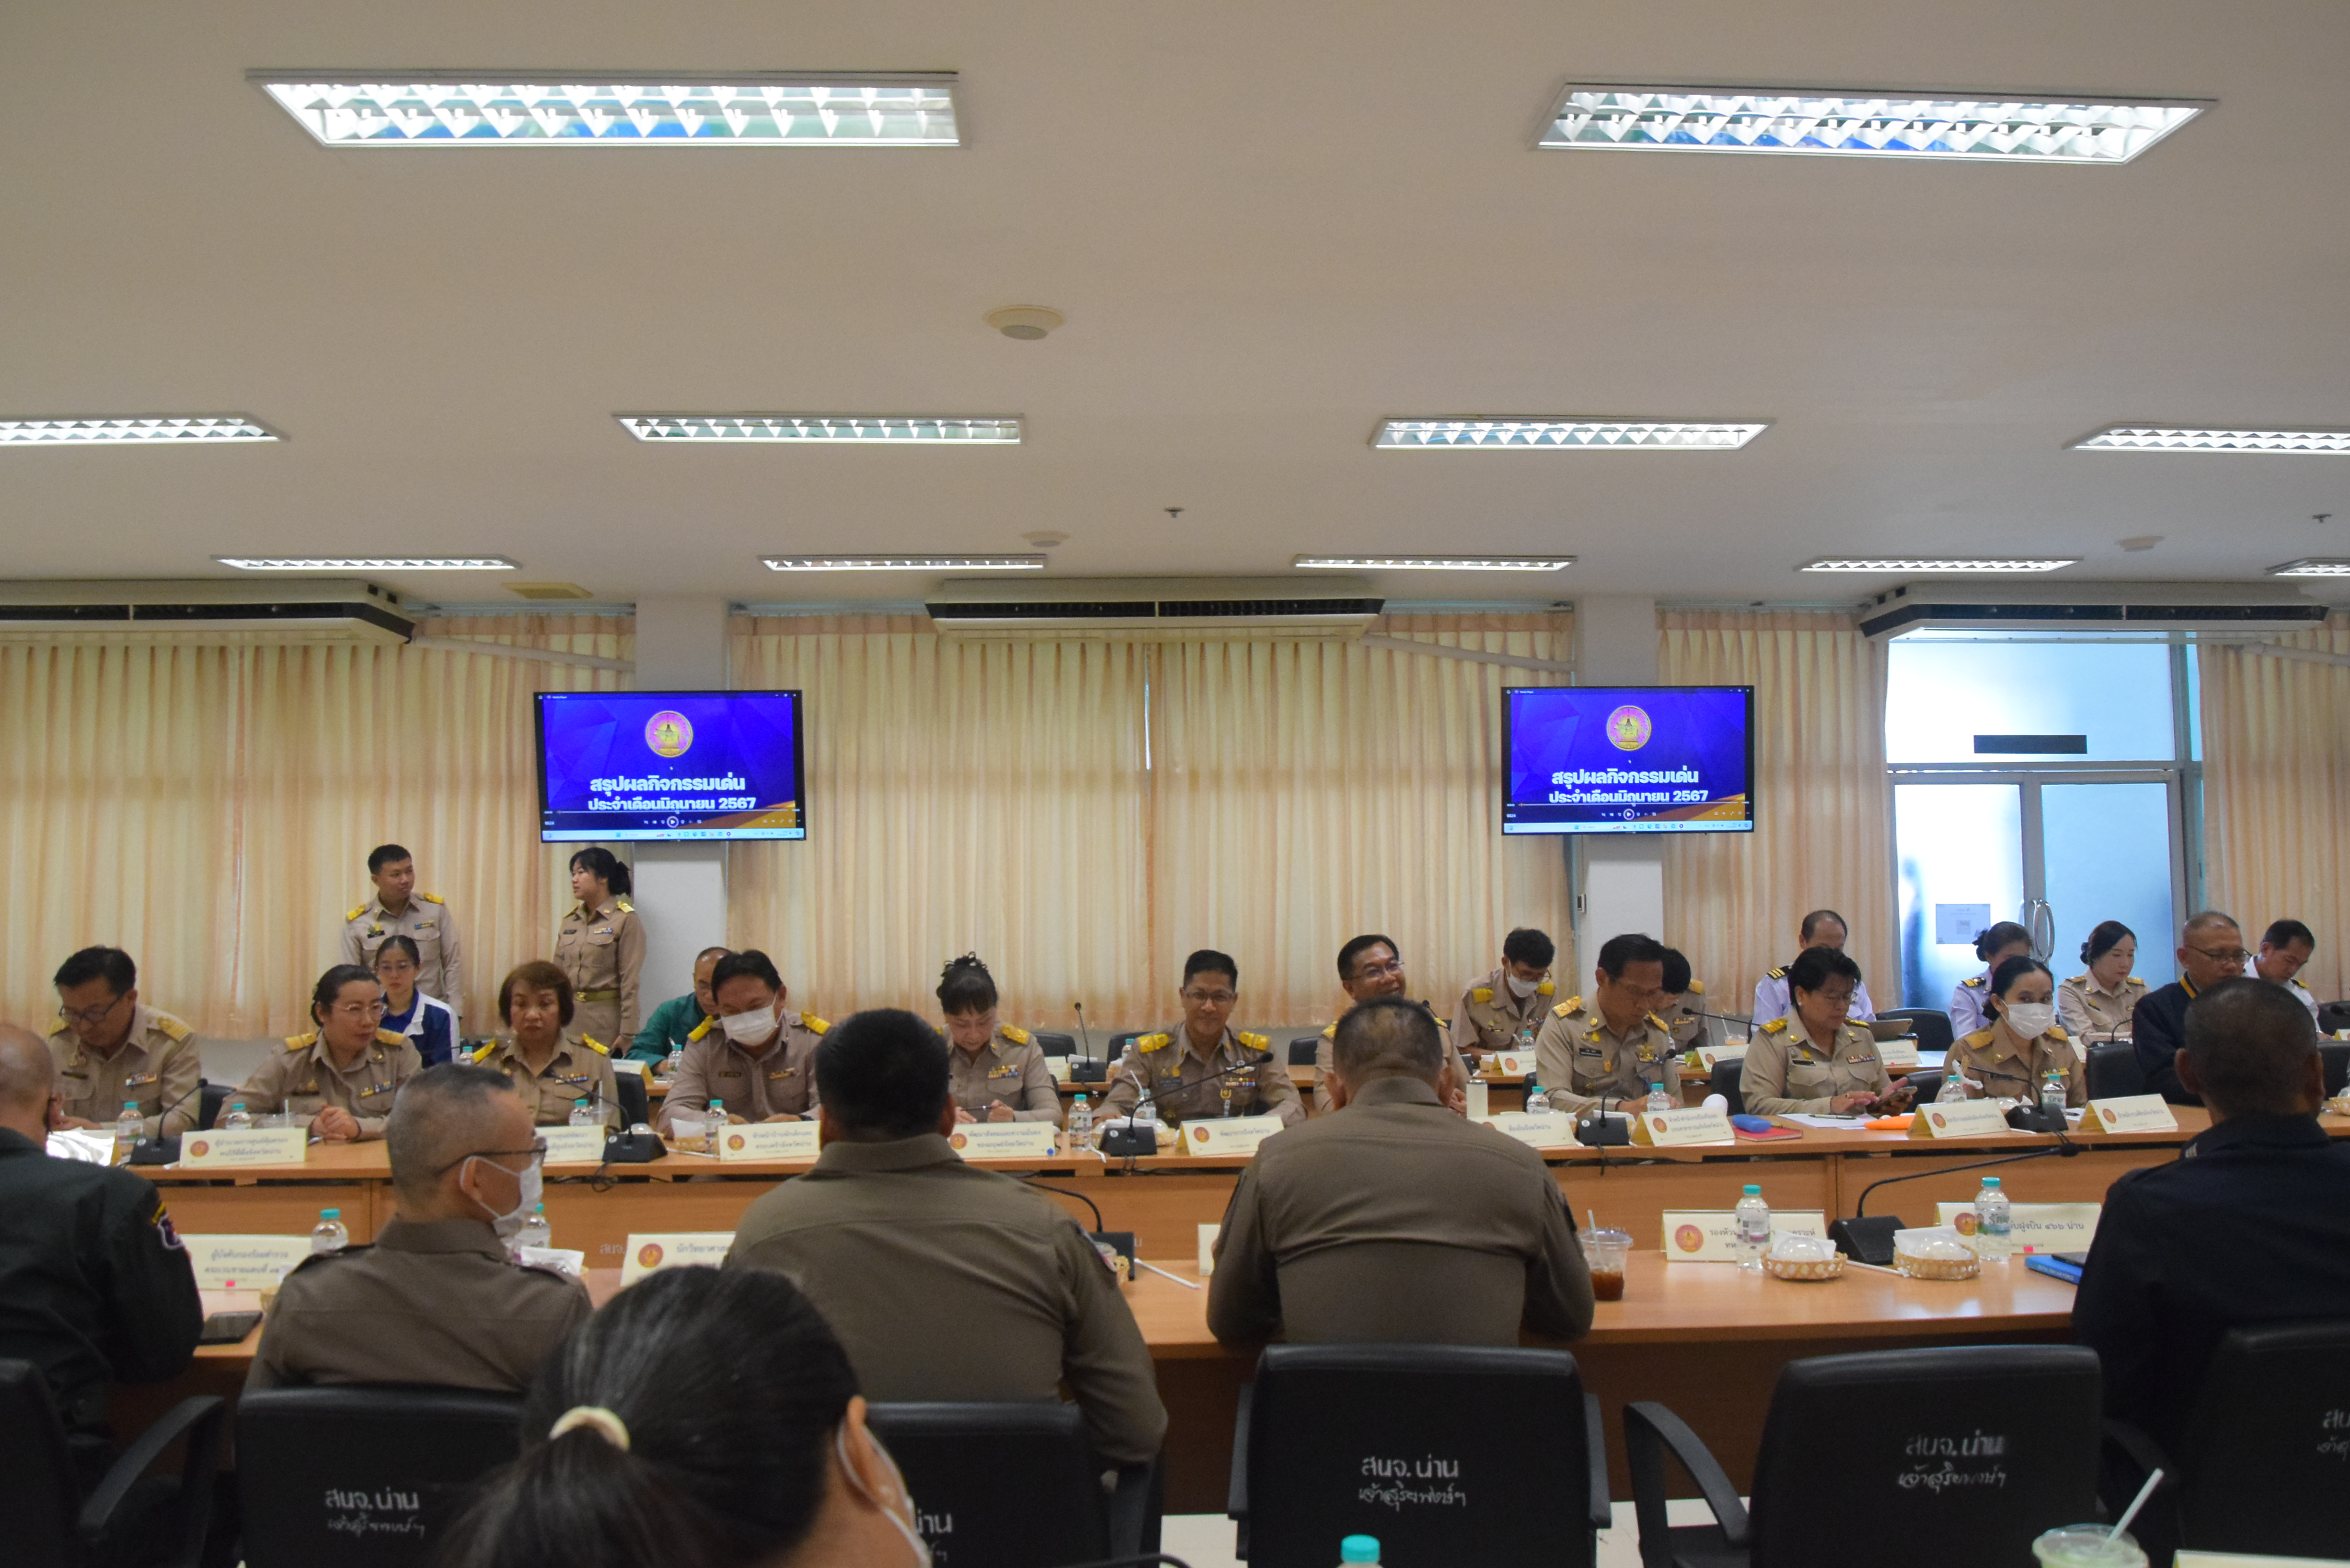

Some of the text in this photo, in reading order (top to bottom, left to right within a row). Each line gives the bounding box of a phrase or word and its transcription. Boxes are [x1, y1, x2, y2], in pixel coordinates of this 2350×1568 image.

[590, 772, 746, 797] สรุปผลกิจกรรมเด่น
[1552, 765, 1699, 789] สรุปผลกิจกรรมเด่น
[588, 796, 756, 814] ประจำเดือนมิถุนายน 2567
[1549, 789, 1709, 806] ประจำเดือนมิถุนายน 2567
[2067, 1221, 2084, 1229] น่าน
